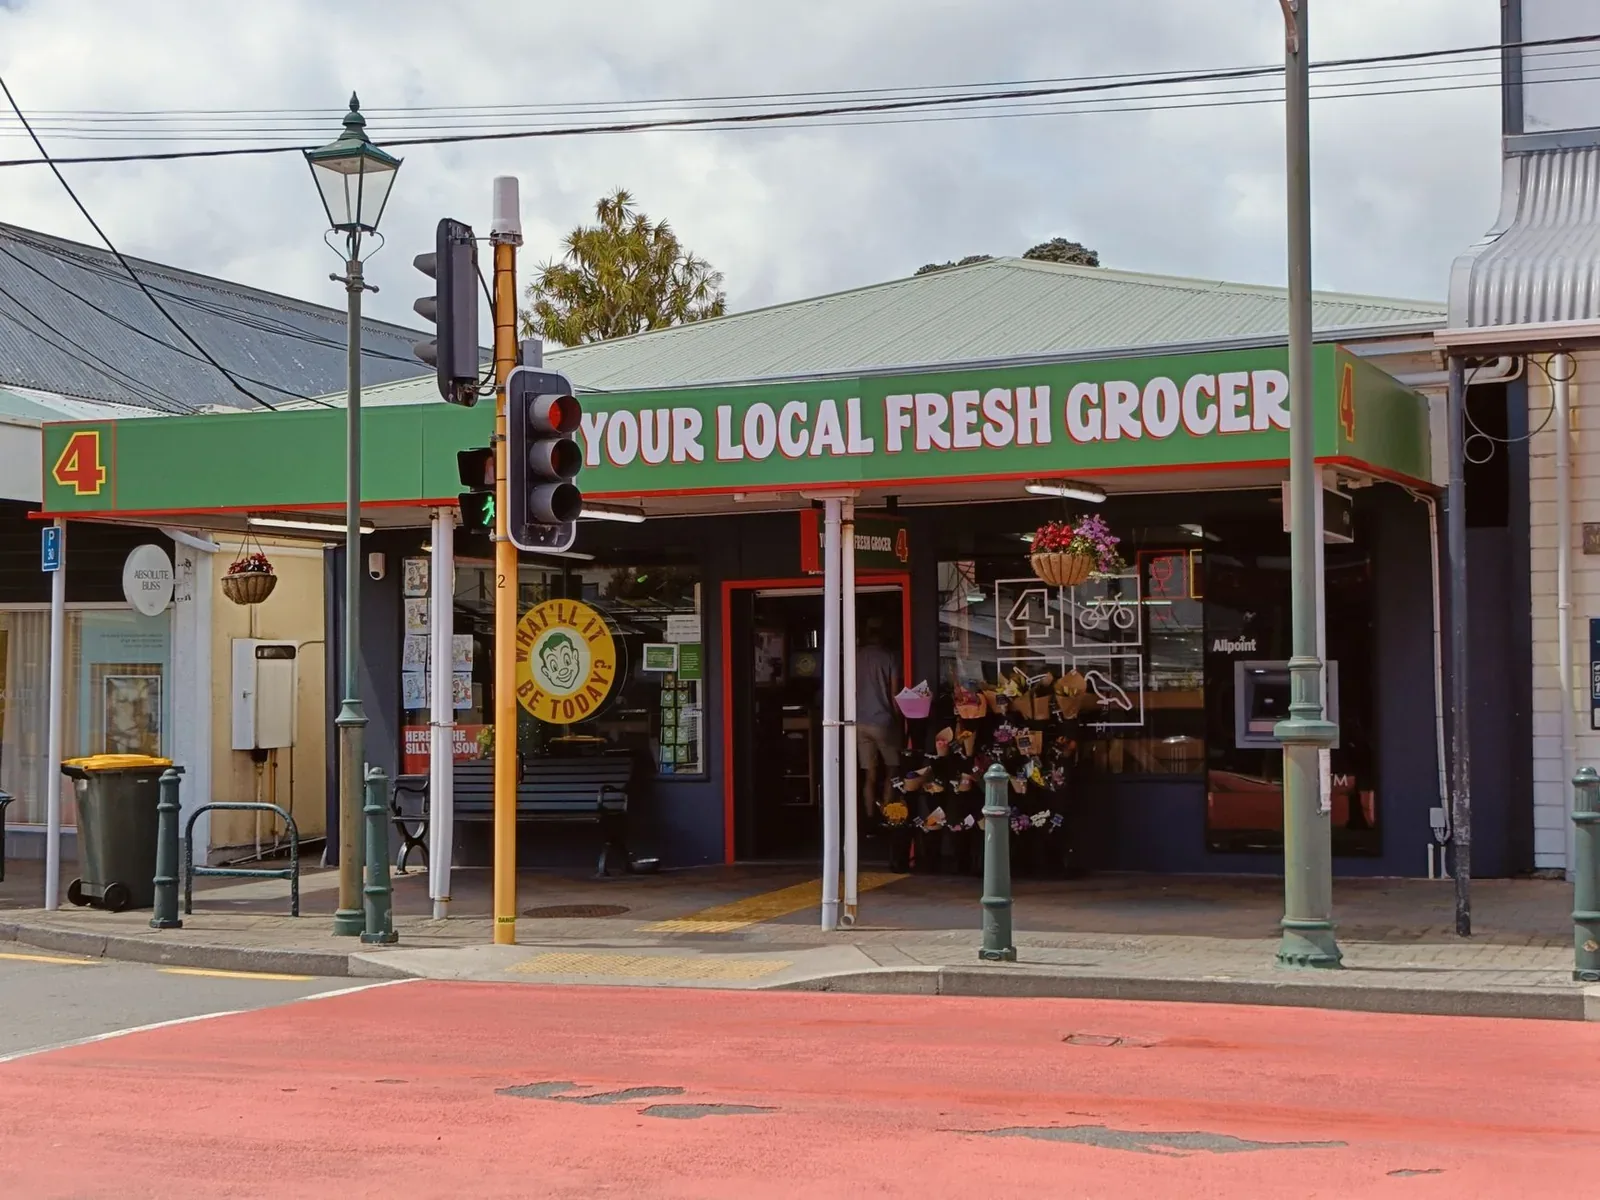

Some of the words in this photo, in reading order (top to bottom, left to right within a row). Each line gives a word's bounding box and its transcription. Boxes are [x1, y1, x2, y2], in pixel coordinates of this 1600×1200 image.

[579, 407, 704, 468] YOUR
[715, 397, 874, 462] LOCAL
[884, 385, 1052, 454] FRESH
[1065, 369, 1291, 444] GROCER
[1338, 362, 1356, 442] 4
[52, 430, 106, 495] 4
[48, 530, 55, 546] P
[854, 535, 871, 550] FRESH
[871, 536, 892, 551] GROCER
[895, 528, 908, 562] 4
[134, 570, 169, 580] ABSOLUTE
[142, 581, 161, 591] BLISS
[497, 574, 506, 588] 2
[516, 603, 578, 663] WHAT'LL
[582, 617, 606, 642] IT
[1005, 588, 1054, 638] 4
[516, 679, 544, 711] BE
[551, 659, 613, 719] TODAY?
